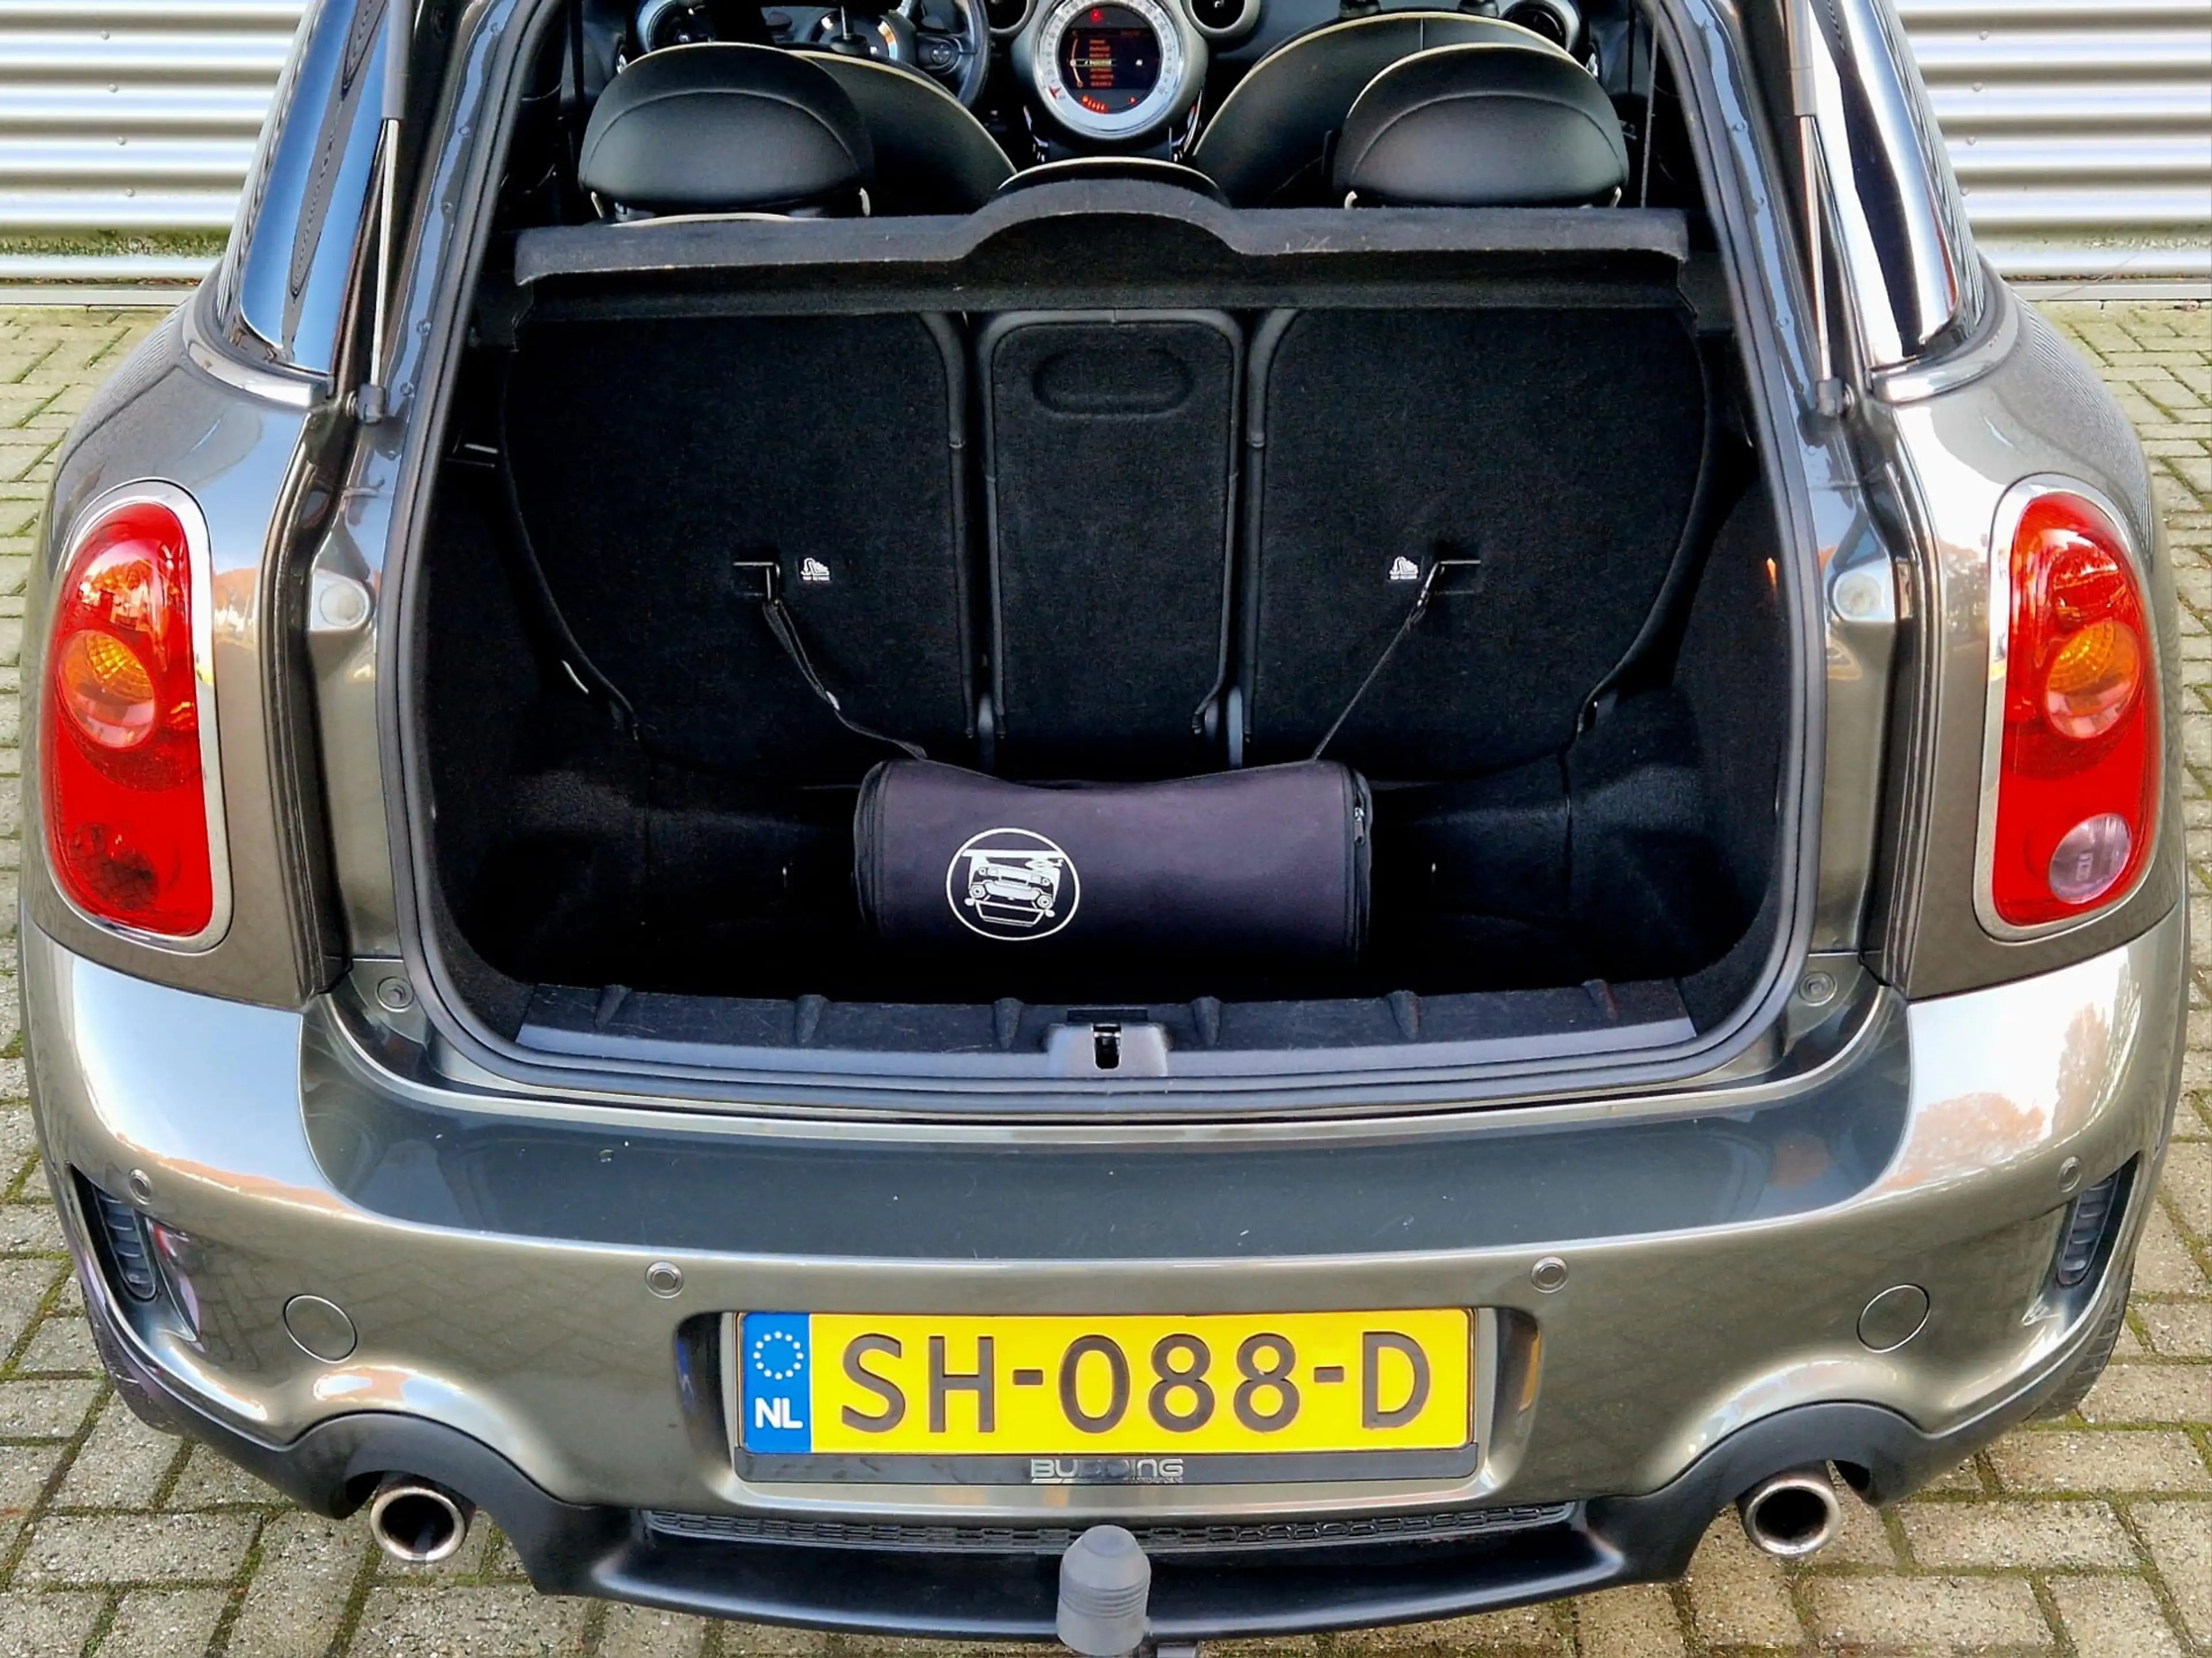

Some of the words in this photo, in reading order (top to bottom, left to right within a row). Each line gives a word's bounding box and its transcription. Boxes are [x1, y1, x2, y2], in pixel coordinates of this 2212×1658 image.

[842, 1332, 1430, 1433] SH-088-D
[755, 1398, 803, 1429] NL
[1031, 1458, 1183, 1478] BUING
